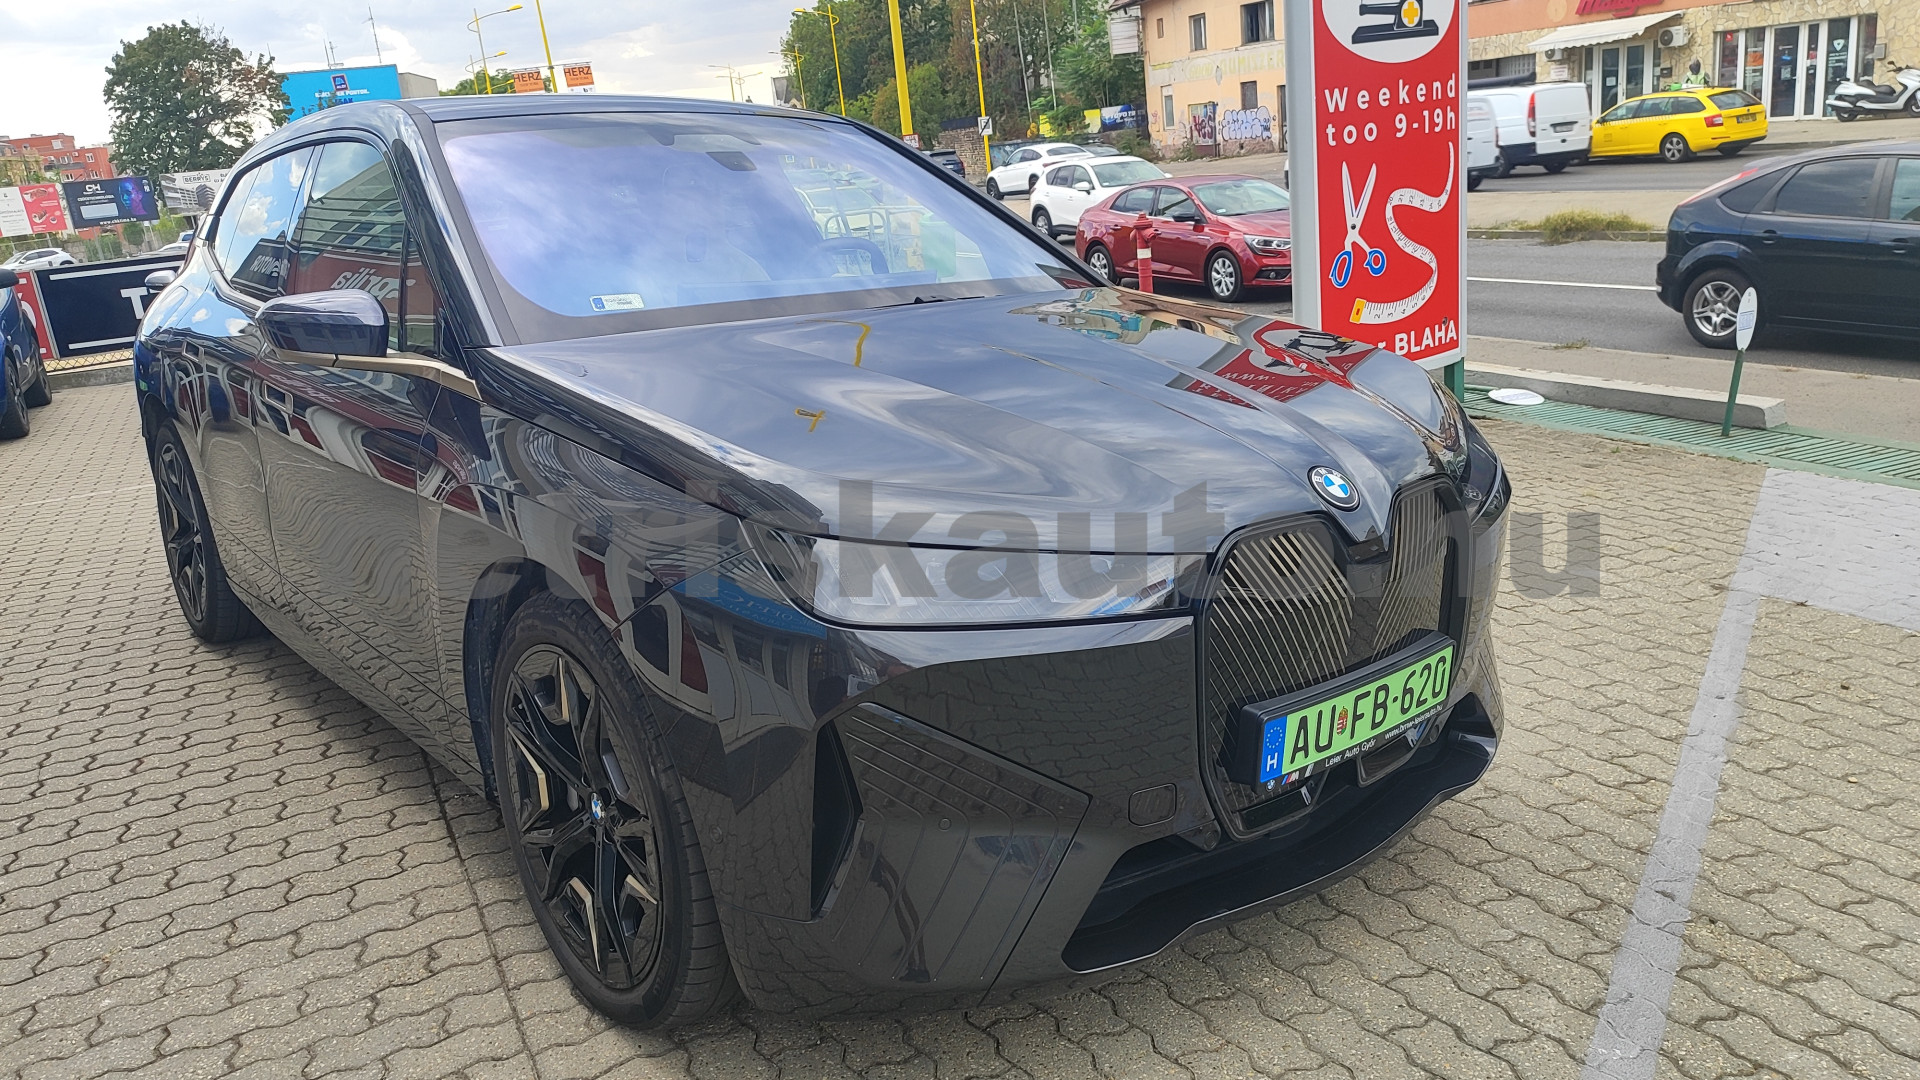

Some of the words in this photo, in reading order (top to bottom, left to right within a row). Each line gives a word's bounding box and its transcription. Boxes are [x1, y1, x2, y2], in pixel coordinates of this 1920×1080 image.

[513, 71, 542, 82] HERZ
[563, 66, 592, 77] HERZ
[1323, 72, 1456, 114] Weekend
[1325, 123, 1379, 147] too
[1394, 105, 1456, 138] 9-19h
[85, 183, 101, 192] CH
[1394, 322, 1459, 356] BLAHA
[1290, 704, 1336, 765] AU
[1350, 655, 1448, 740] FB-620
[1266, 752, 1278, 772] H
[1325, 754, 1342, 768] Leier
[1344, 745, 1360, 759] Autó
